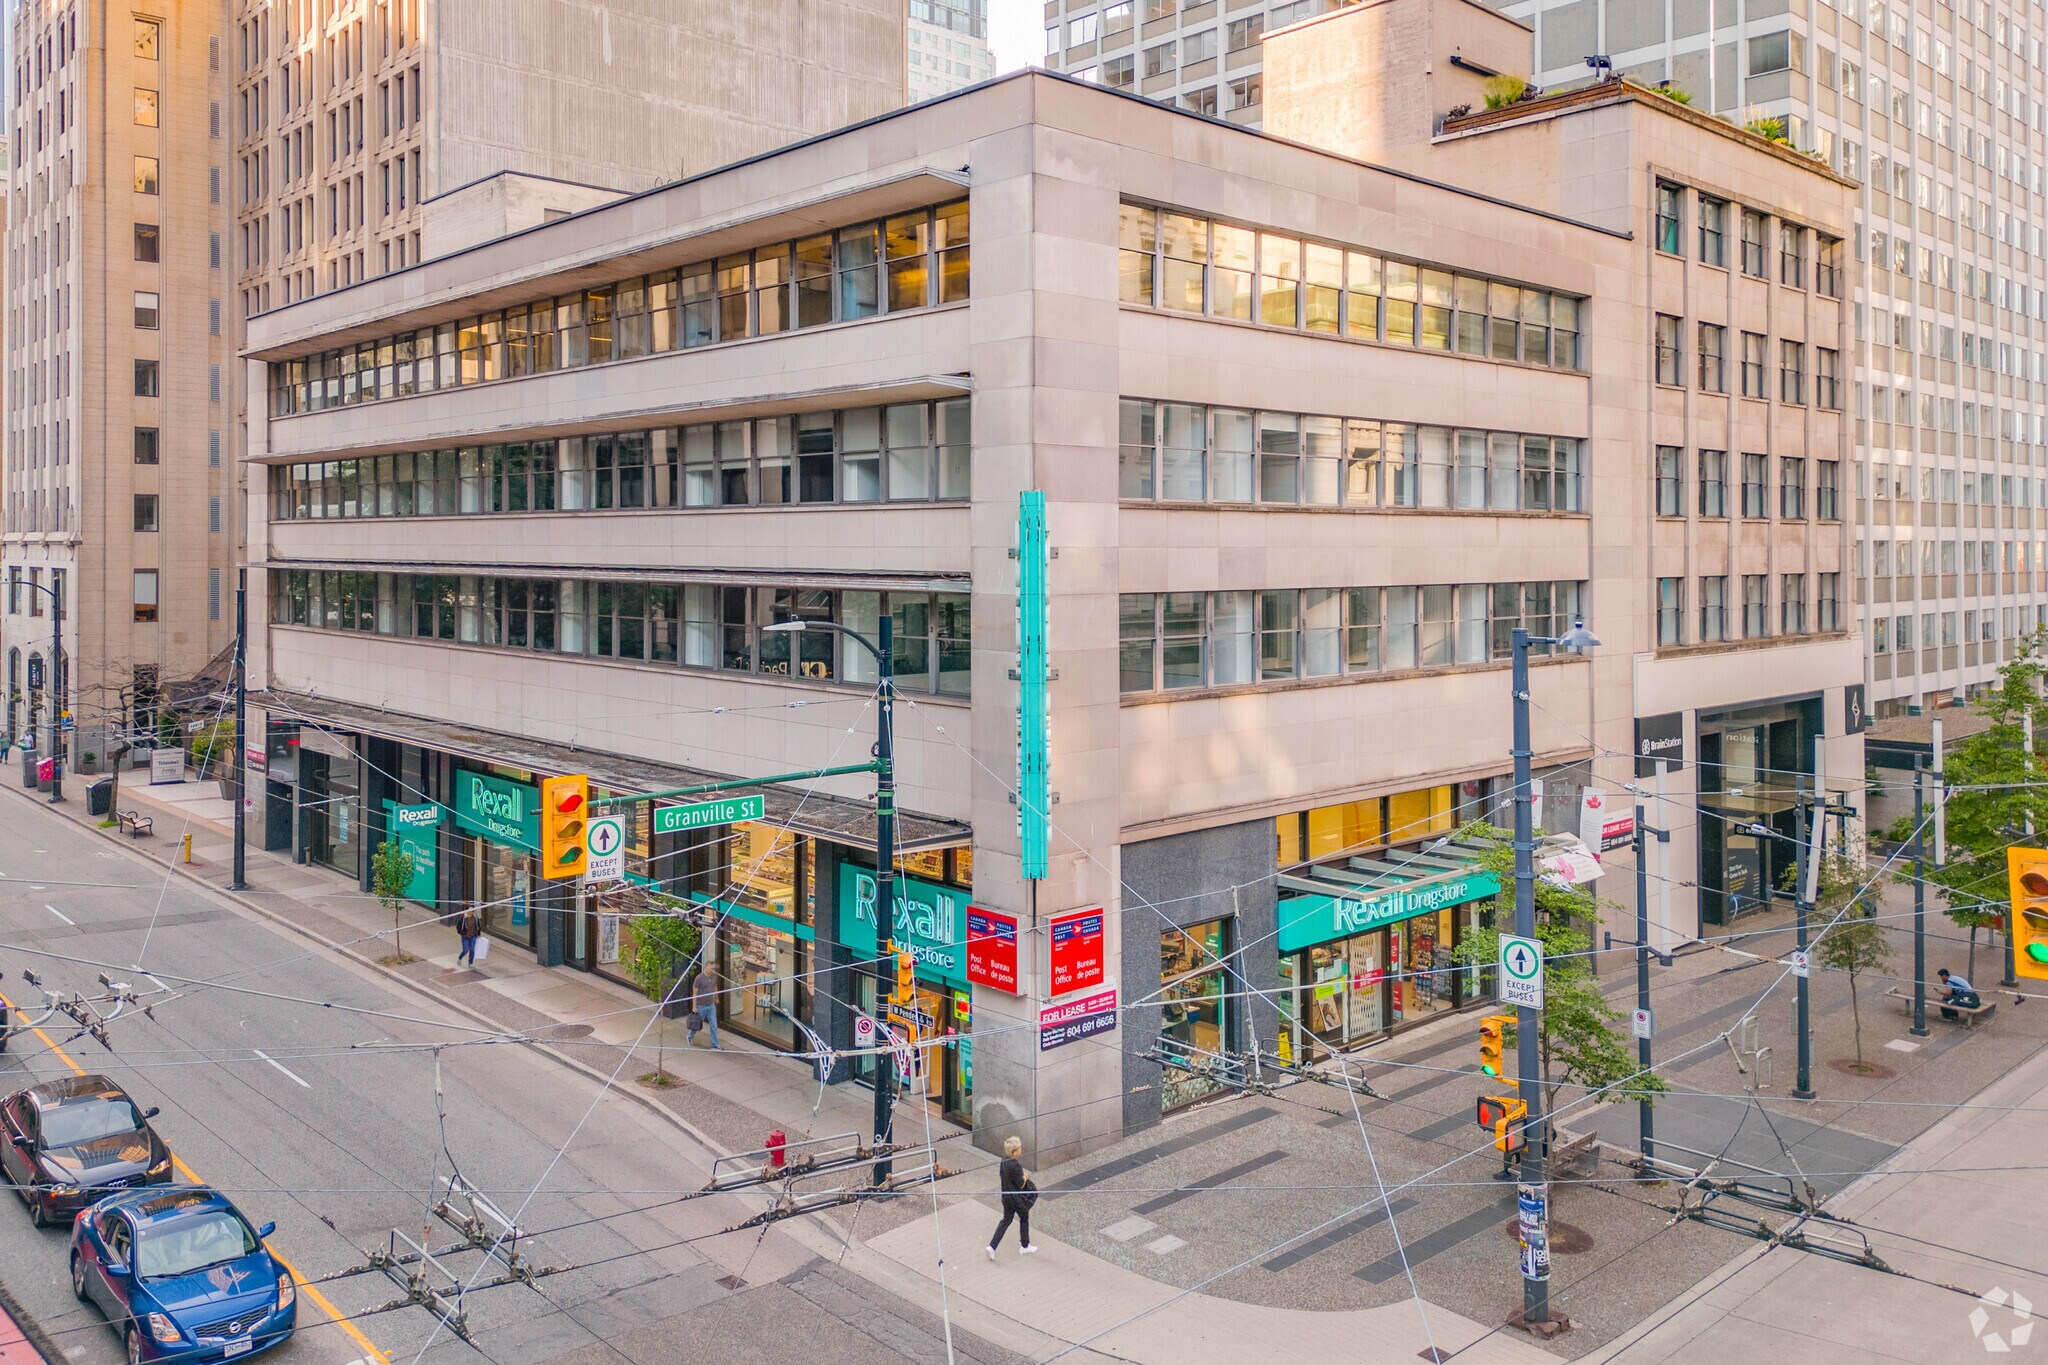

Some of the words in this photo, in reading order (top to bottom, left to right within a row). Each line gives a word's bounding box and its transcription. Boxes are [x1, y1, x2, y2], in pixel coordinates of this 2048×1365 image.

[1650, 737, 1682, 751] BrainStation
[472, 777, 522, 823] Rexall
[399, 805, 438, 823] Rexall
[664, 805, 735, 828] Granville
[741, 800, 755, 818] St
[412, 818, 438, 827] Drugstore
[488, 818, 521, 839] Drugstore
[590, 857, 618, 869] EXCEPT
[591, 867, 616, 879] BUSES
[1406, 881, 1468, 911] Drugstore
[856, 873, 955, 946] Rxall
[1334, 887, 1404, 932] Rexall
[970, 915, 987, 924] CANADA
[970, 923, 981, 931] POST
[996, 922, 1012, 931] POSTES
[1054, 924, 1072, 933] CANADA
[1082, 926, 1100, 934] CANADA
[970, 953, 983, 964] Post
[1076, 958, 1097, 970] Bureau
[970, 963, 987, 976] Office
[990, 959, 1010, 973] Bureau
[1055, 964, 1068, 975] Post
[990, 969, 999, 979] de
[999, 972, 1014, 984] poste
[1055, 974, 1073, 985] Office
[1076, 971, 1084, 980] de
[1085, 967, 1100, 979] poste
[1506, 979, 1536, 993] EXCEPT
[1508, 989, 1534, 1003] BUSES
[1043, 1011, 1060, 1023] FOR
[1060, 1003, 1086, 1019] LEASE
[1066, 1024, 1081, 1038] 604
[1082, 1020, 1095, 1032] 691
